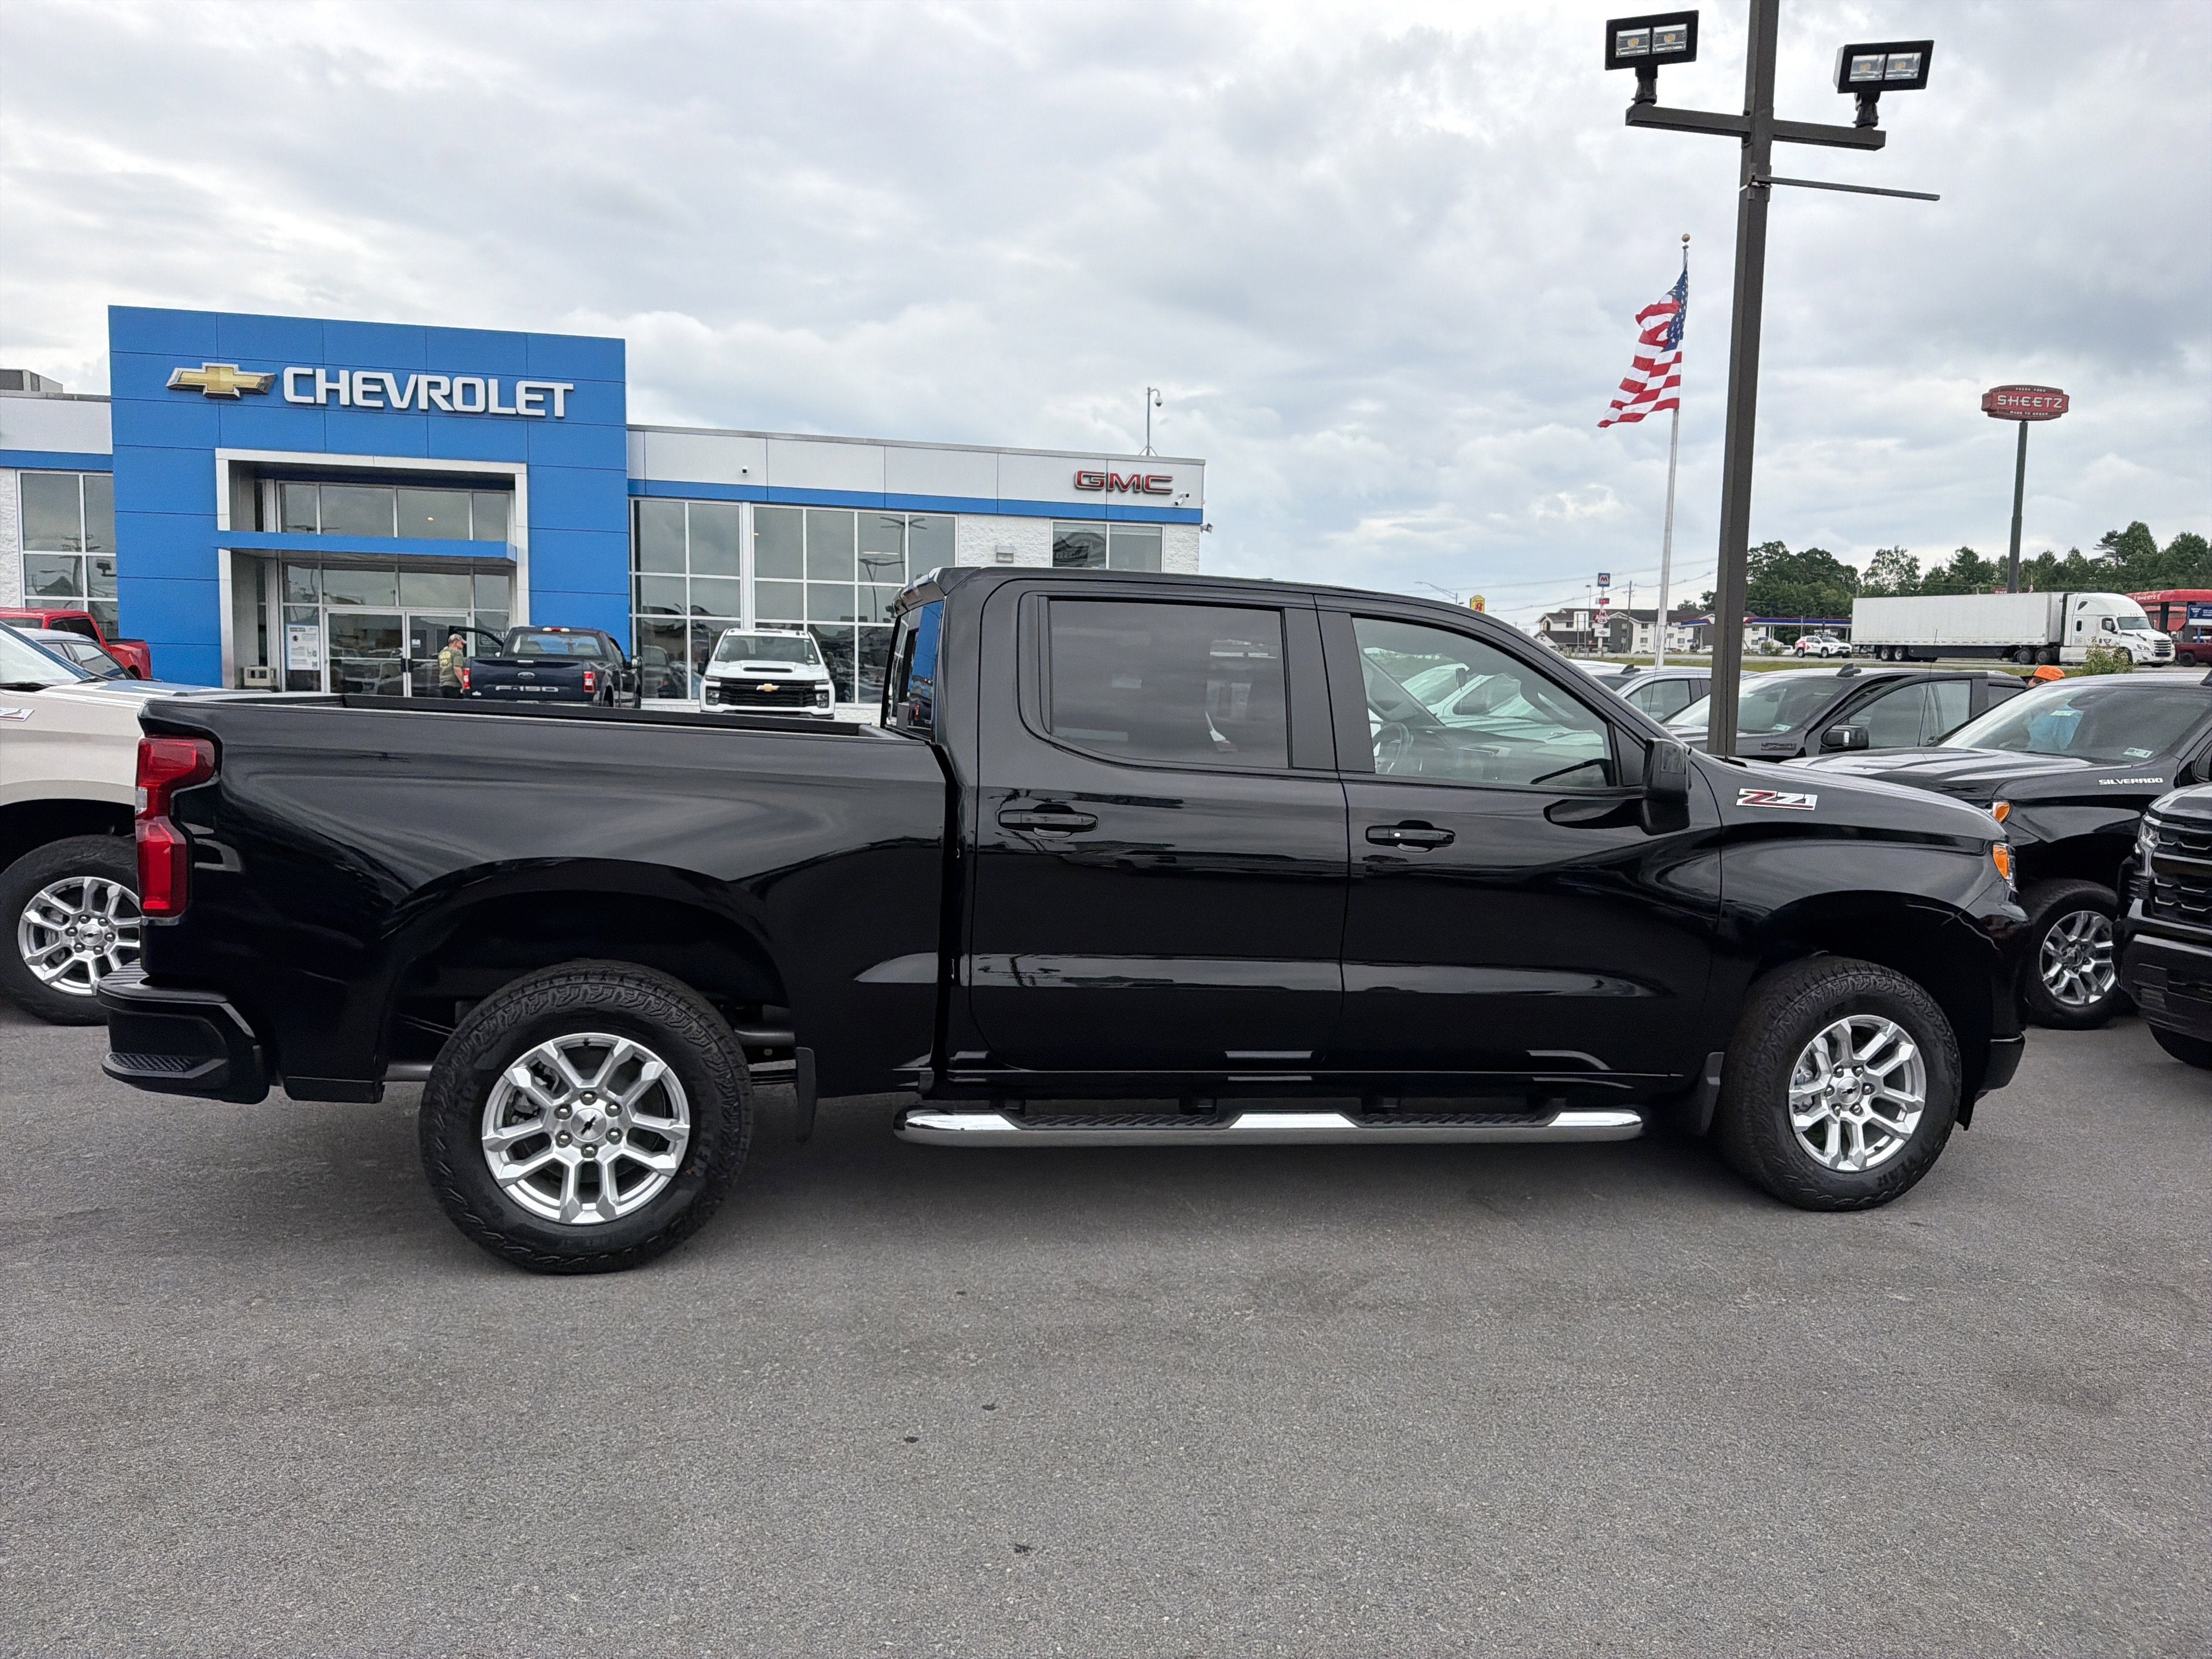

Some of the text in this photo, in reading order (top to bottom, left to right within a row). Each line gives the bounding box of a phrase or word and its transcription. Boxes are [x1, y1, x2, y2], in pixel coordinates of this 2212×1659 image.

[284, 366, 574, 418] CHEVROLET
[1997, 394, 2063, 408] SHEETZ
[1074, 470, 1173, 494] GMC
[2098, 777, 2164, 786] SILVERADO
[1736, 788, 1818, 810] Z71
